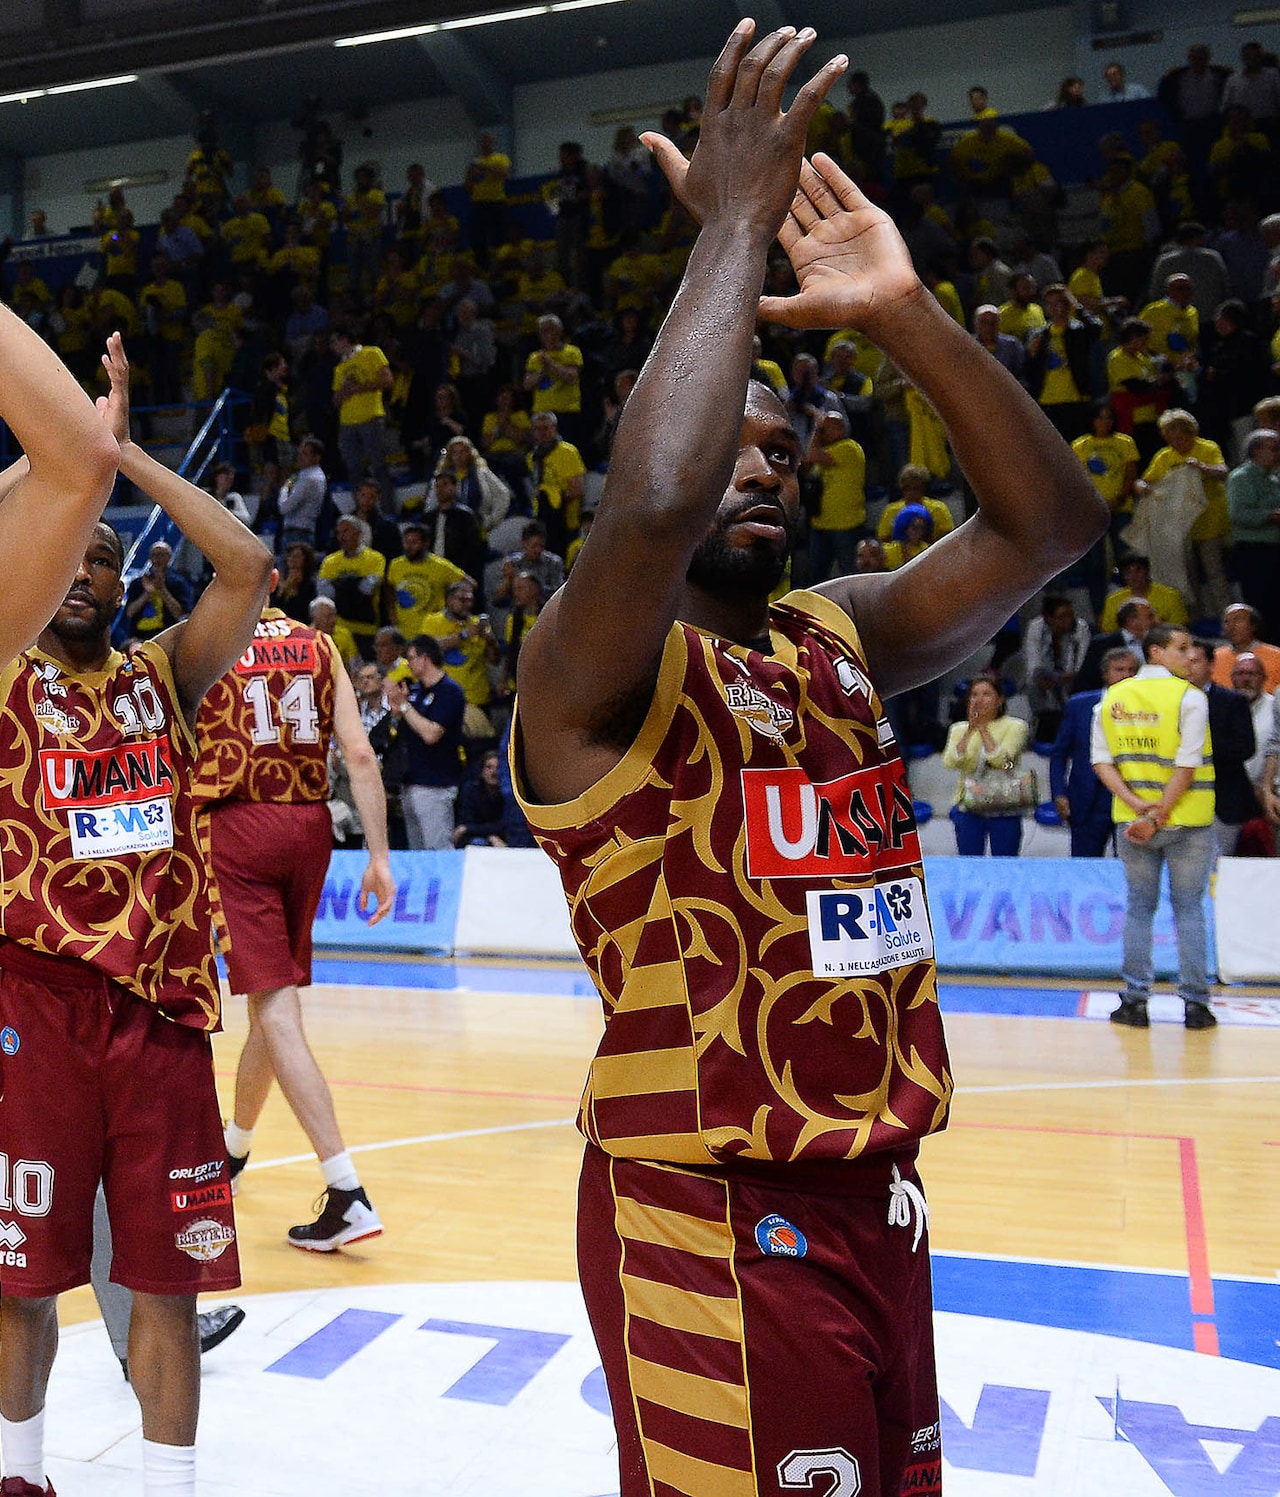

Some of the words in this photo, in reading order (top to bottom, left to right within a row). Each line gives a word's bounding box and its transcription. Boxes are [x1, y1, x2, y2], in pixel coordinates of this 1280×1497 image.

[43, 681, 68, 698] rea
[114, 676, 166, 736] 10
[243, 674, 320, 746] 14
[46, 746, 173, 800] UMANA
[939, 888, 1179, 947] VANO
[884, 929, 921, 950] Salute
[825, 963, 836, 972] N.
[901, 947, 925, 960] SALUTE
[169, 1161, 224, 1180] ORLERTV
[176, 1187, 226, 1209] UMANA
